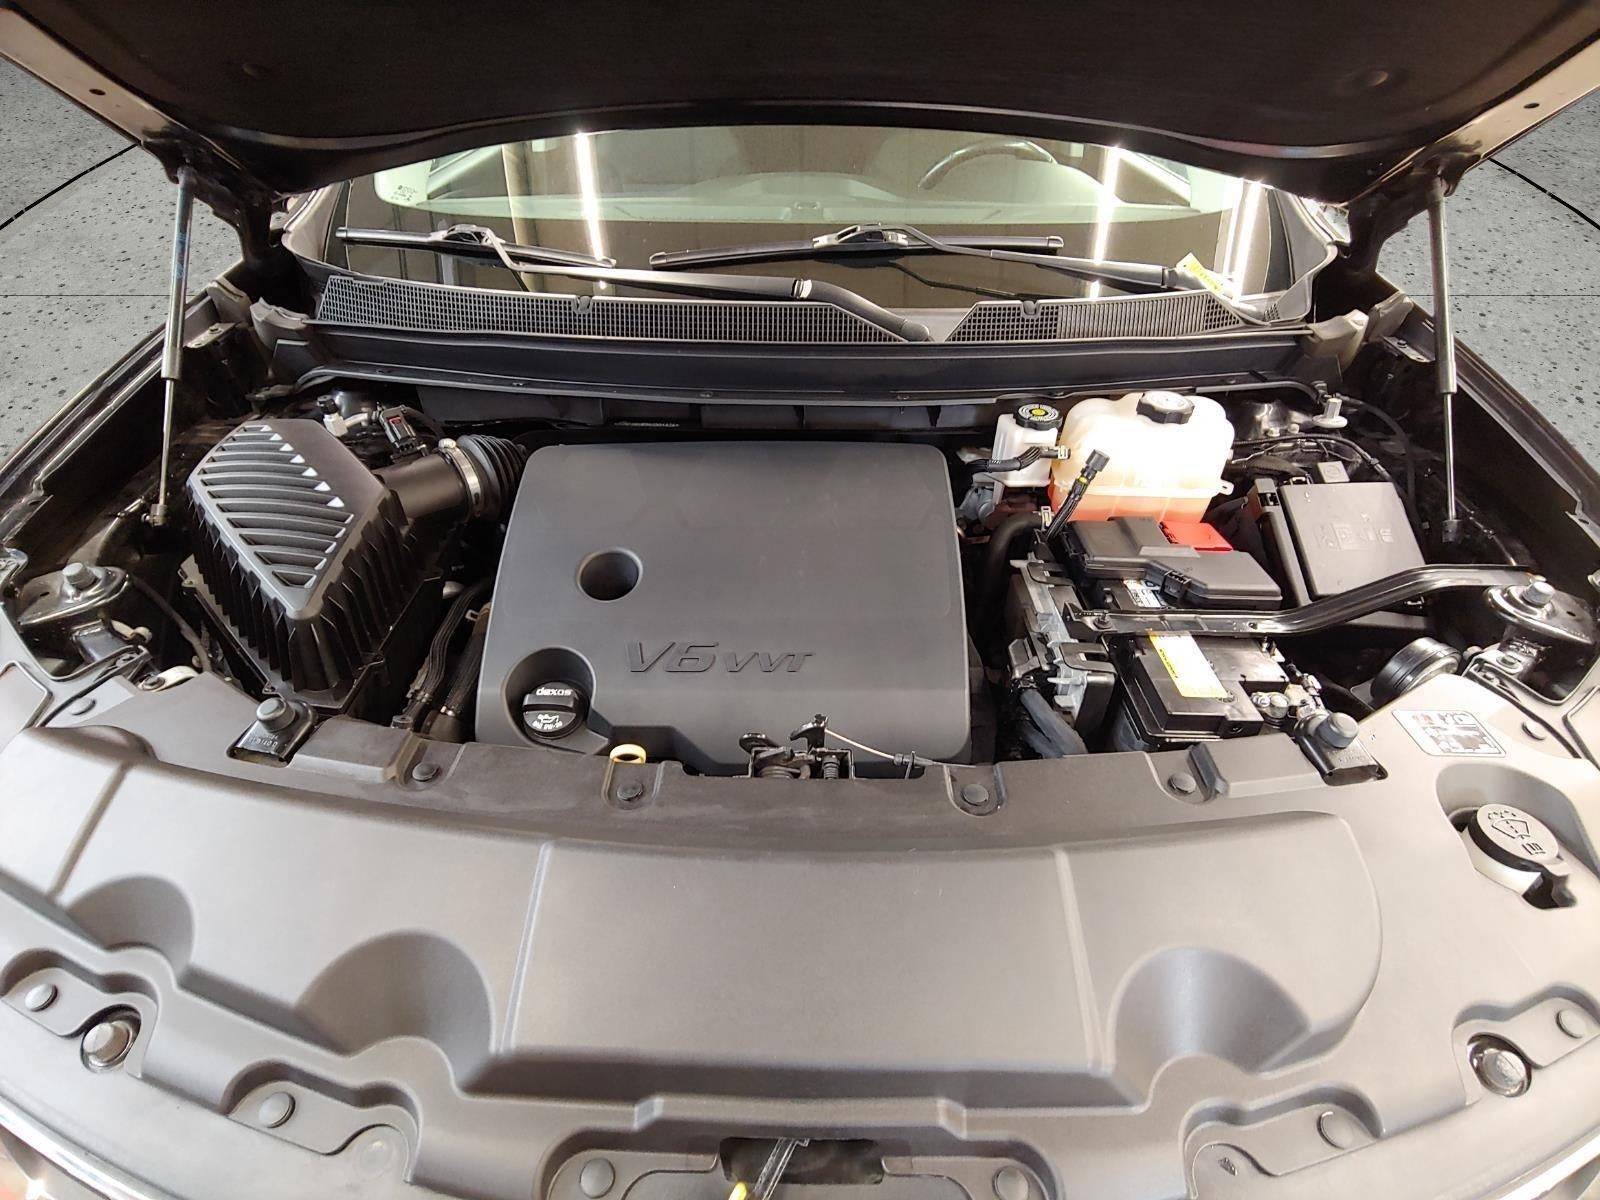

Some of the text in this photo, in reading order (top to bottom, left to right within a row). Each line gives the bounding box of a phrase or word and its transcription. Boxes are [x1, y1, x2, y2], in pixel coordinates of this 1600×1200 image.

[626, 641, 815, 673] V6 VVT
[536, 687, 573, 696] dexos
